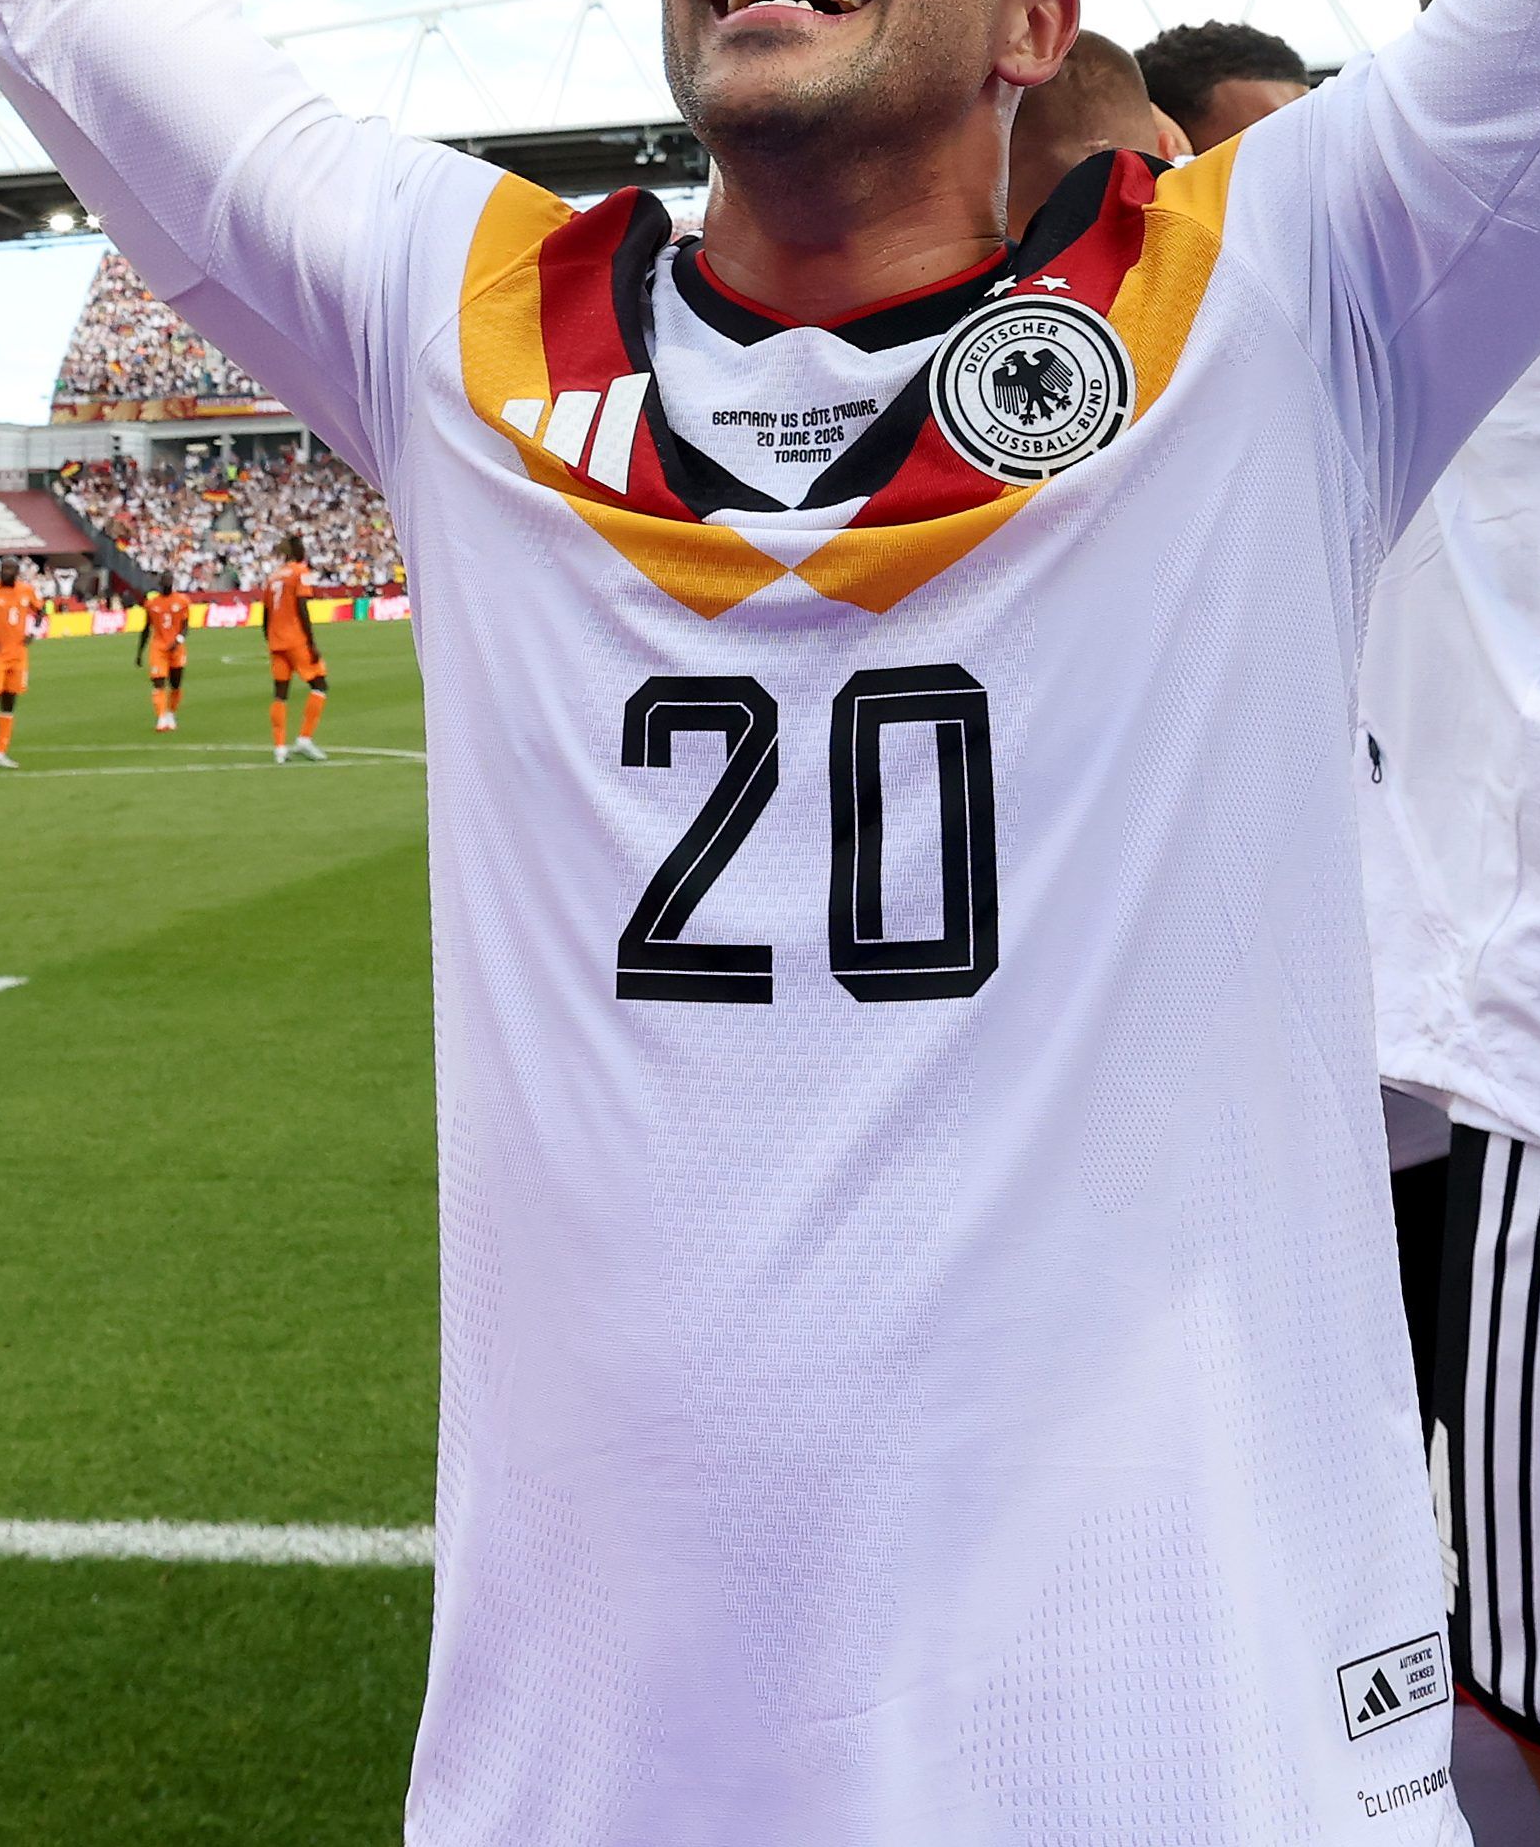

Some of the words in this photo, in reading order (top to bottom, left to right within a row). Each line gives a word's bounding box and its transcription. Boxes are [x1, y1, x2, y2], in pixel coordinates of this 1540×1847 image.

[965, 322, 1059, 373] DEUTSCHER
[713, 411, 777, 428] GERMANY
[802, 407, 830, 426] CÔTE
[985, 379, 1103, 453] FUSSBALL-BUND
[757, 432, 774, 447] 20
[778, 432, 810, 447] JUNE
[814, 426, 844, 445] 2026
[774, 448, 832, 463] TORONTO
[616, 663, 999, 1004] 20
[1399, 1648, 1433, 1670] AUTHENTIC
[1406, 1665, 1435, 1685] LICENSED
[1409, 1681, 1437, 1702] PRODUCT
